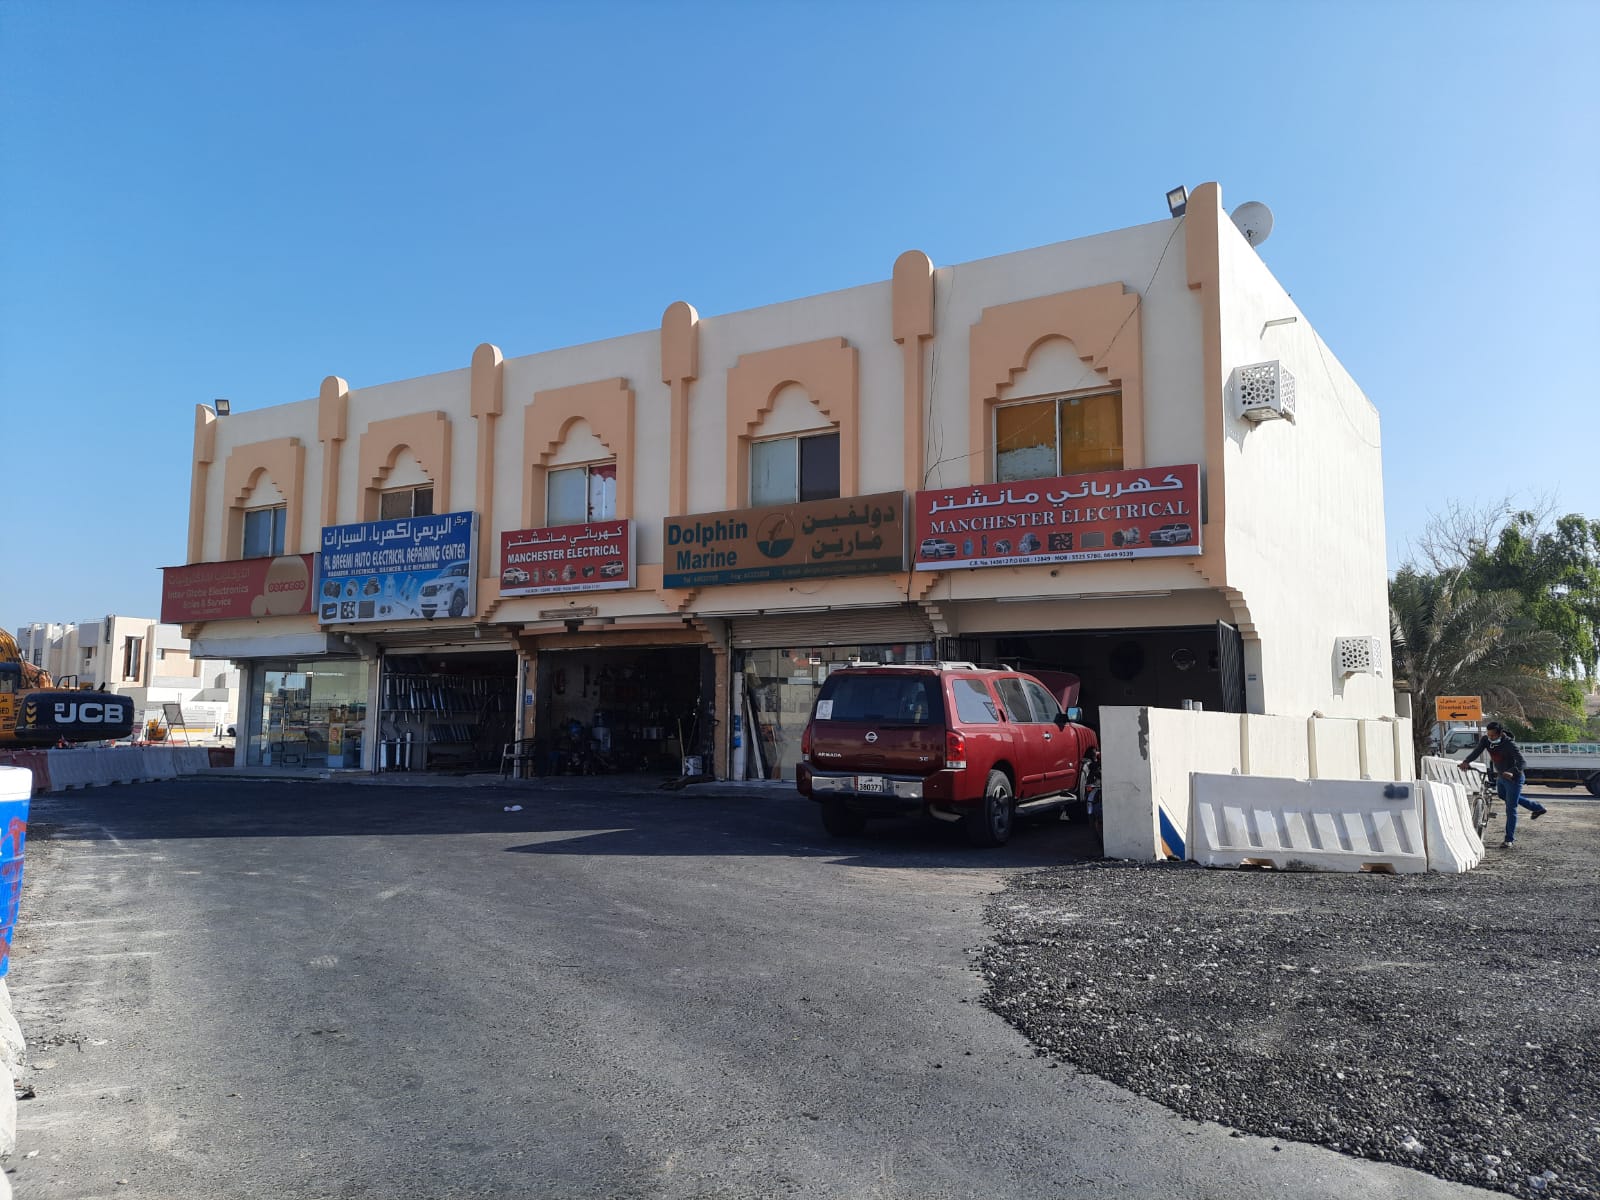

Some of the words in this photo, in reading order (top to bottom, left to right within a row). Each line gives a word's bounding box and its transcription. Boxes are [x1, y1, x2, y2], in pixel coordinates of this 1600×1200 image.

[928, 488, 1040, 515] مانشتر
[801, 503, 895, 534] دولفين
[930, 511, 1054, 535] MANCHESTER
[1061, 500, 1190, 524] ELECTRICAL
[324, 526, 366, 550] السيارات
[668, 518, 748, 547] Dolphin
[811, 530, 883, 559] مارين
[354, 551, 371, 567] AUTO
[372, 547, 405, 565] ELECTRICAL
[406, 545, 440, 563] REPAIRING
[441, 543, 466, 560] CENTER
[507, 549, 564, 564] MANCHESTER
[566, 545, 620, 559] ELECTRICAL
[676, 548, 737, 570] Marine
[207, 598, 231, 607] Service
[208, 585, 249, 597] Electronics
[54, 703, 123, 723] JCB
